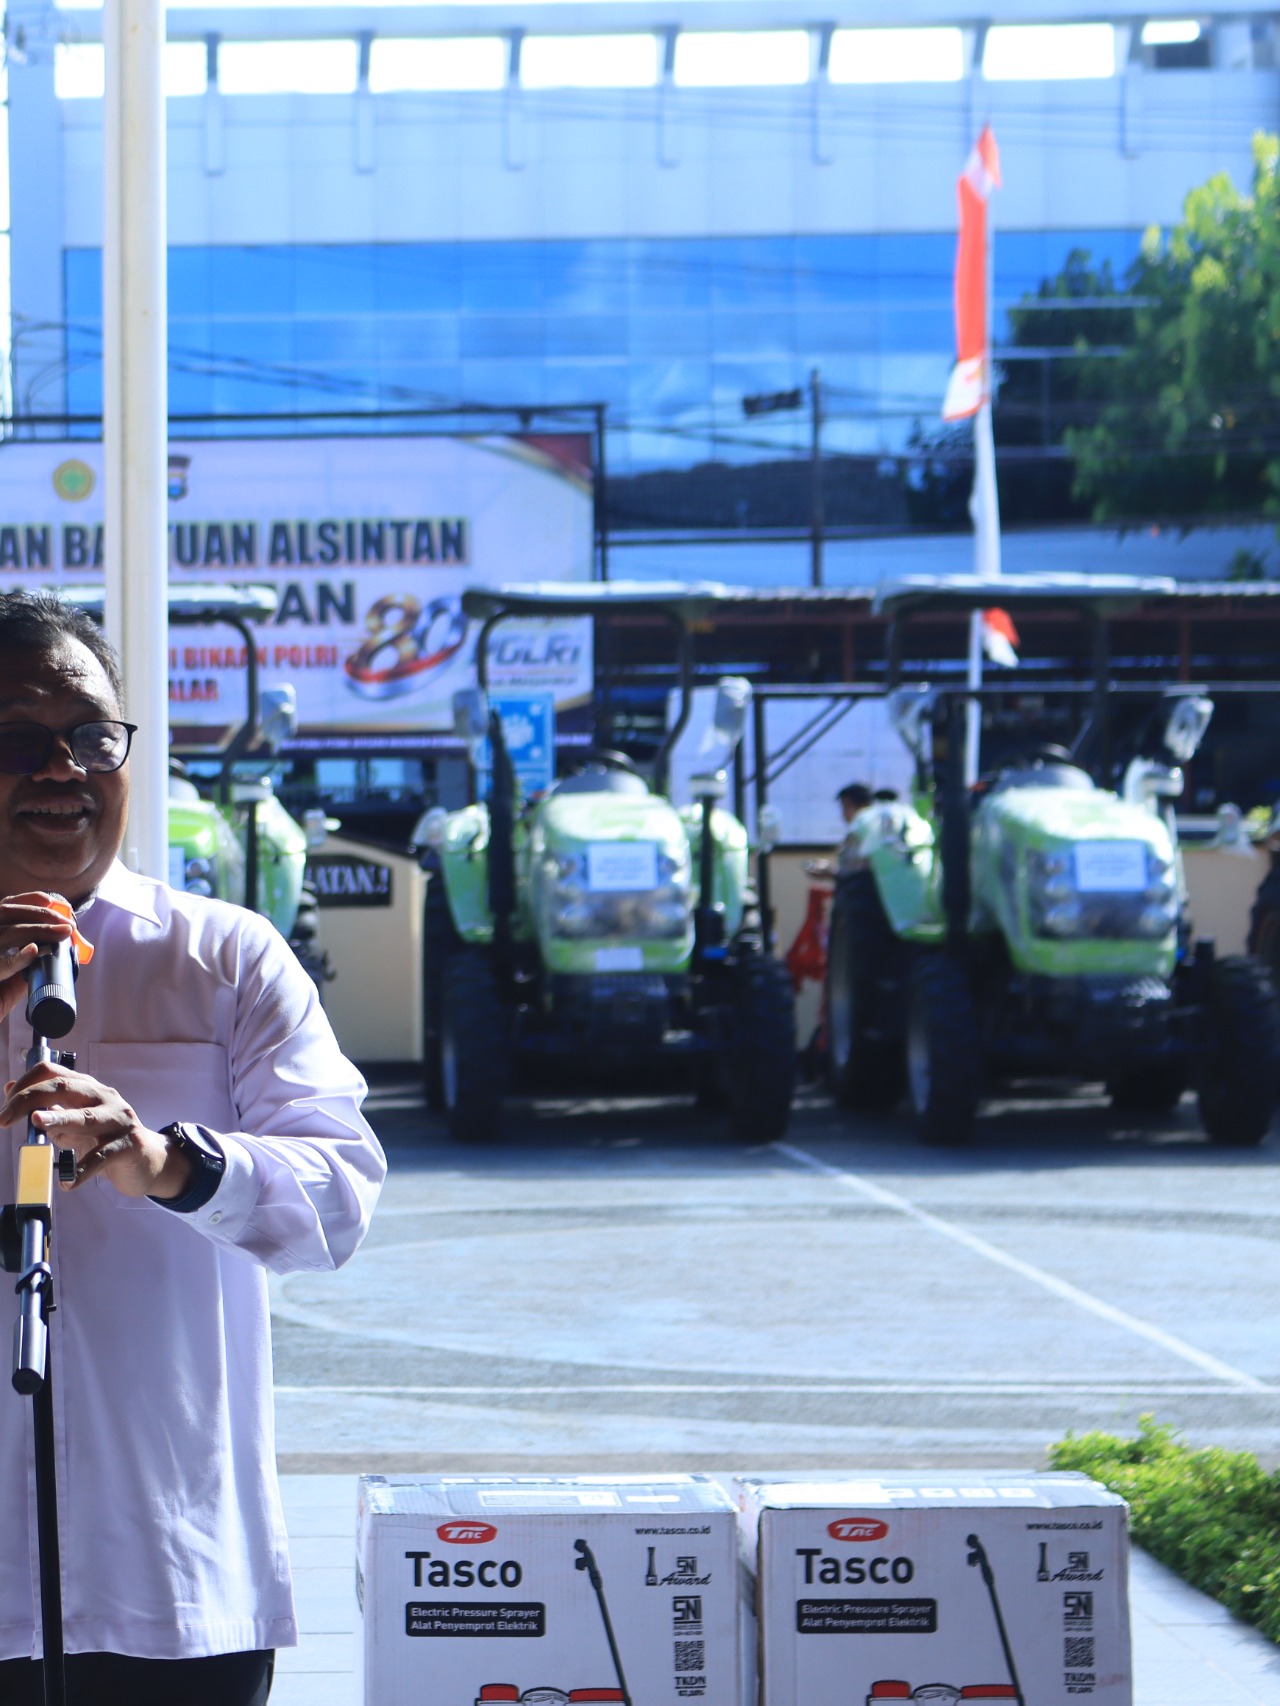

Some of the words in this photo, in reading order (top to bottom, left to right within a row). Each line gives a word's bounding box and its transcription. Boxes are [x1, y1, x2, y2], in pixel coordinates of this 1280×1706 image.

[269, 520, 467, 565] ALSINTAN
[274, 644, 339, 669] POLRI
[405, 1551, 522, 1588] Tasco
[795, 1548, 914, 1585] Tasco
[411, 1607, 449, 1617] Electric
[452, 1608, 498, 1617] Pressure
[499, 1608, 541, 1619] Sprayer
[801, 1604, 841, 1614] Electric
[843, 1605, 889, 1614] Pressure
[891, 1604, 933, 1616] Sprayer
[411, 1621, 433, 1630] Alat
[435, 1621, 495, 1632] Penyemprot
[497, 1621, 538, 1631] Elektrik
